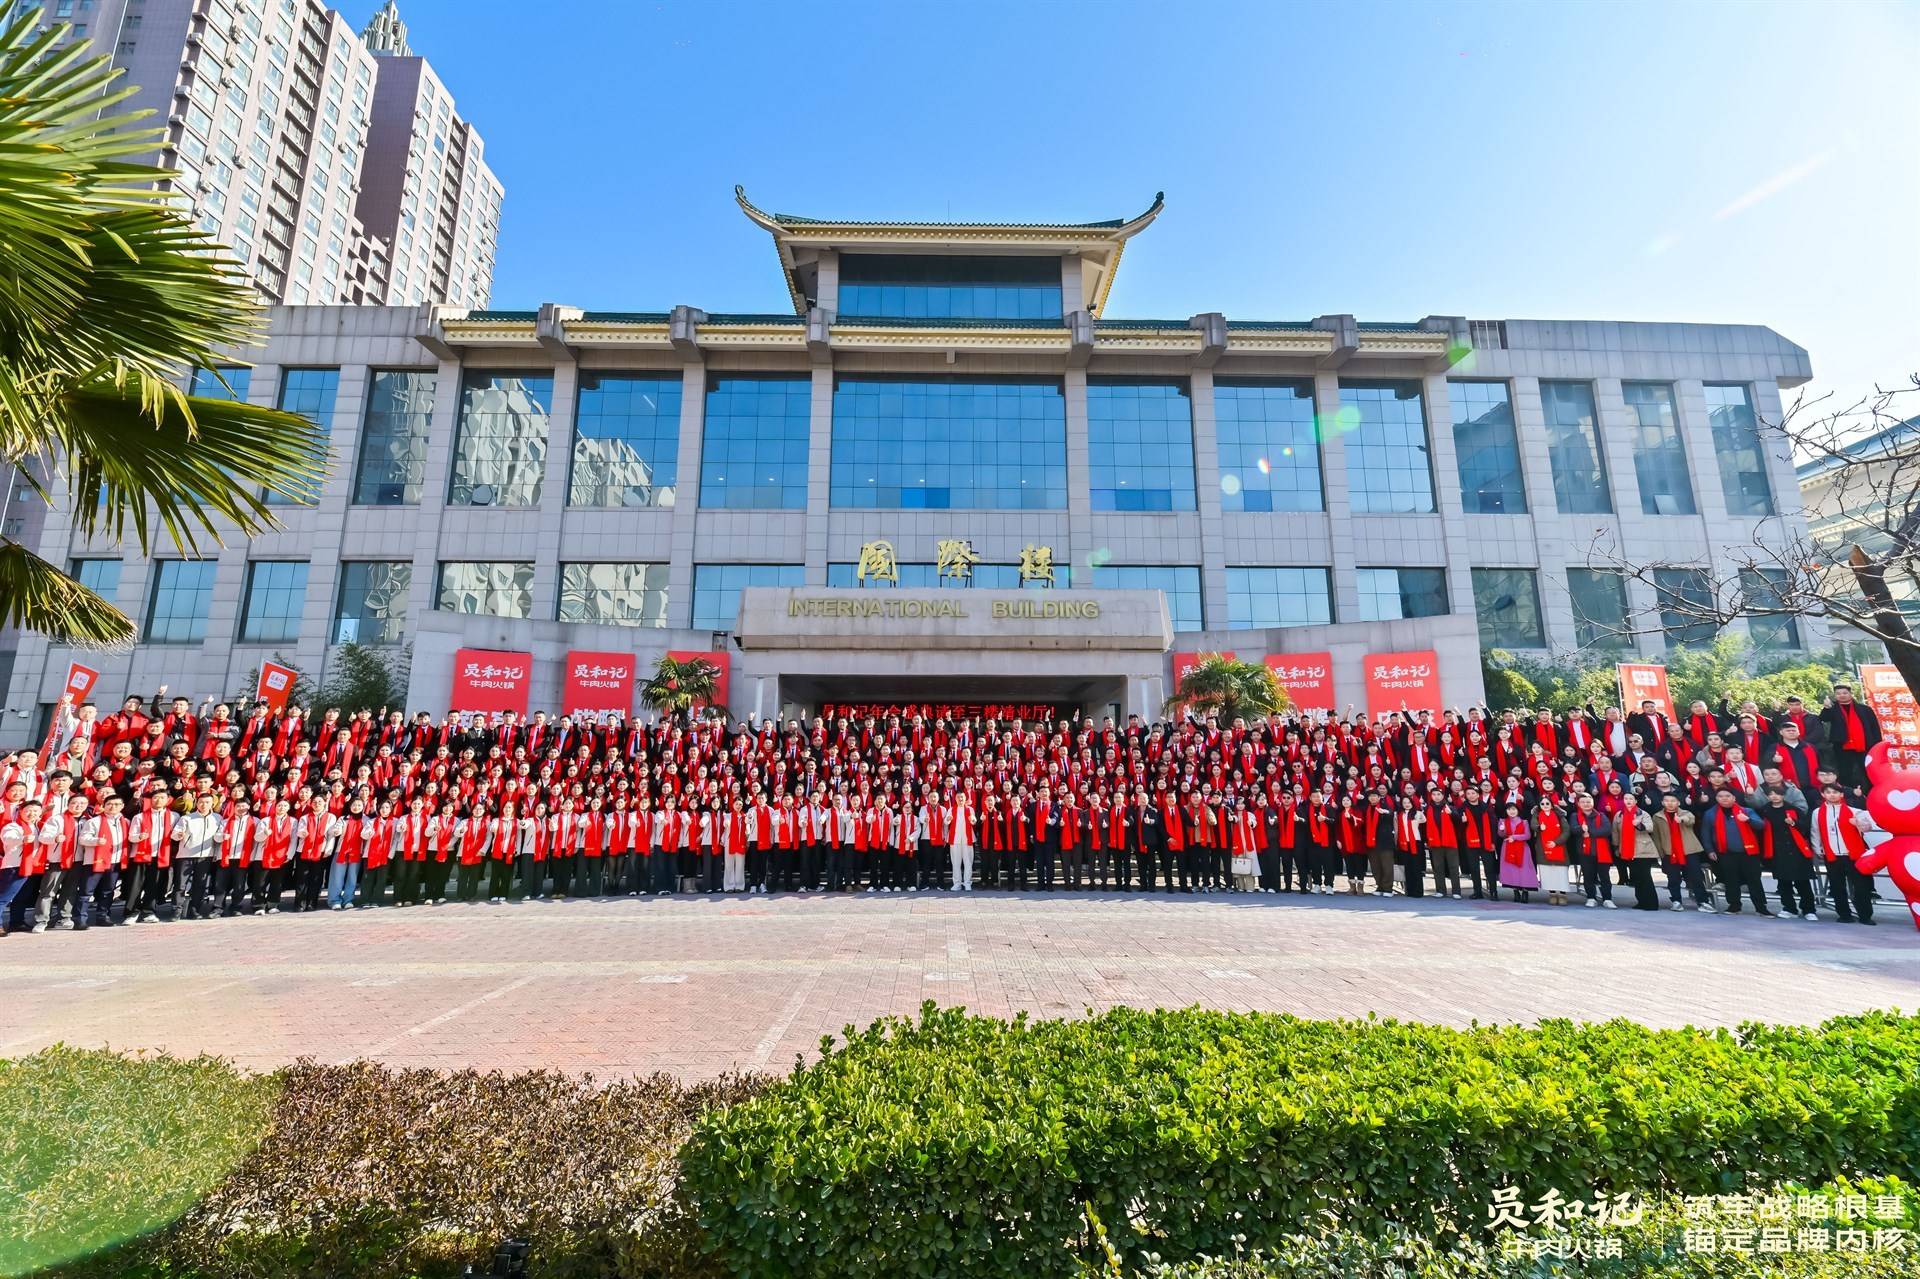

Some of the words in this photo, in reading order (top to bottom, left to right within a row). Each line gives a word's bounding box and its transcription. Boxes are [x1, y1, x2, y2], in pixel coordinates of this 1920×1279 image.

[788, 599, 969, 618] INTERNATIONAL
[992, 600, 1099, 619] BUILDING
[463, 664, 524, 679] 员和记
[574, 664, 628, 679] 员和记
[1272, 665, 1325, 679] 员和记
[1373, 664, 1431, 680] 员和记
[470, 680, 515, 689] 牛肉火锅
[580, 680, 621, 689] 牛肉火锅
[1381, 680, 1424, 689] 牛肉火锅
